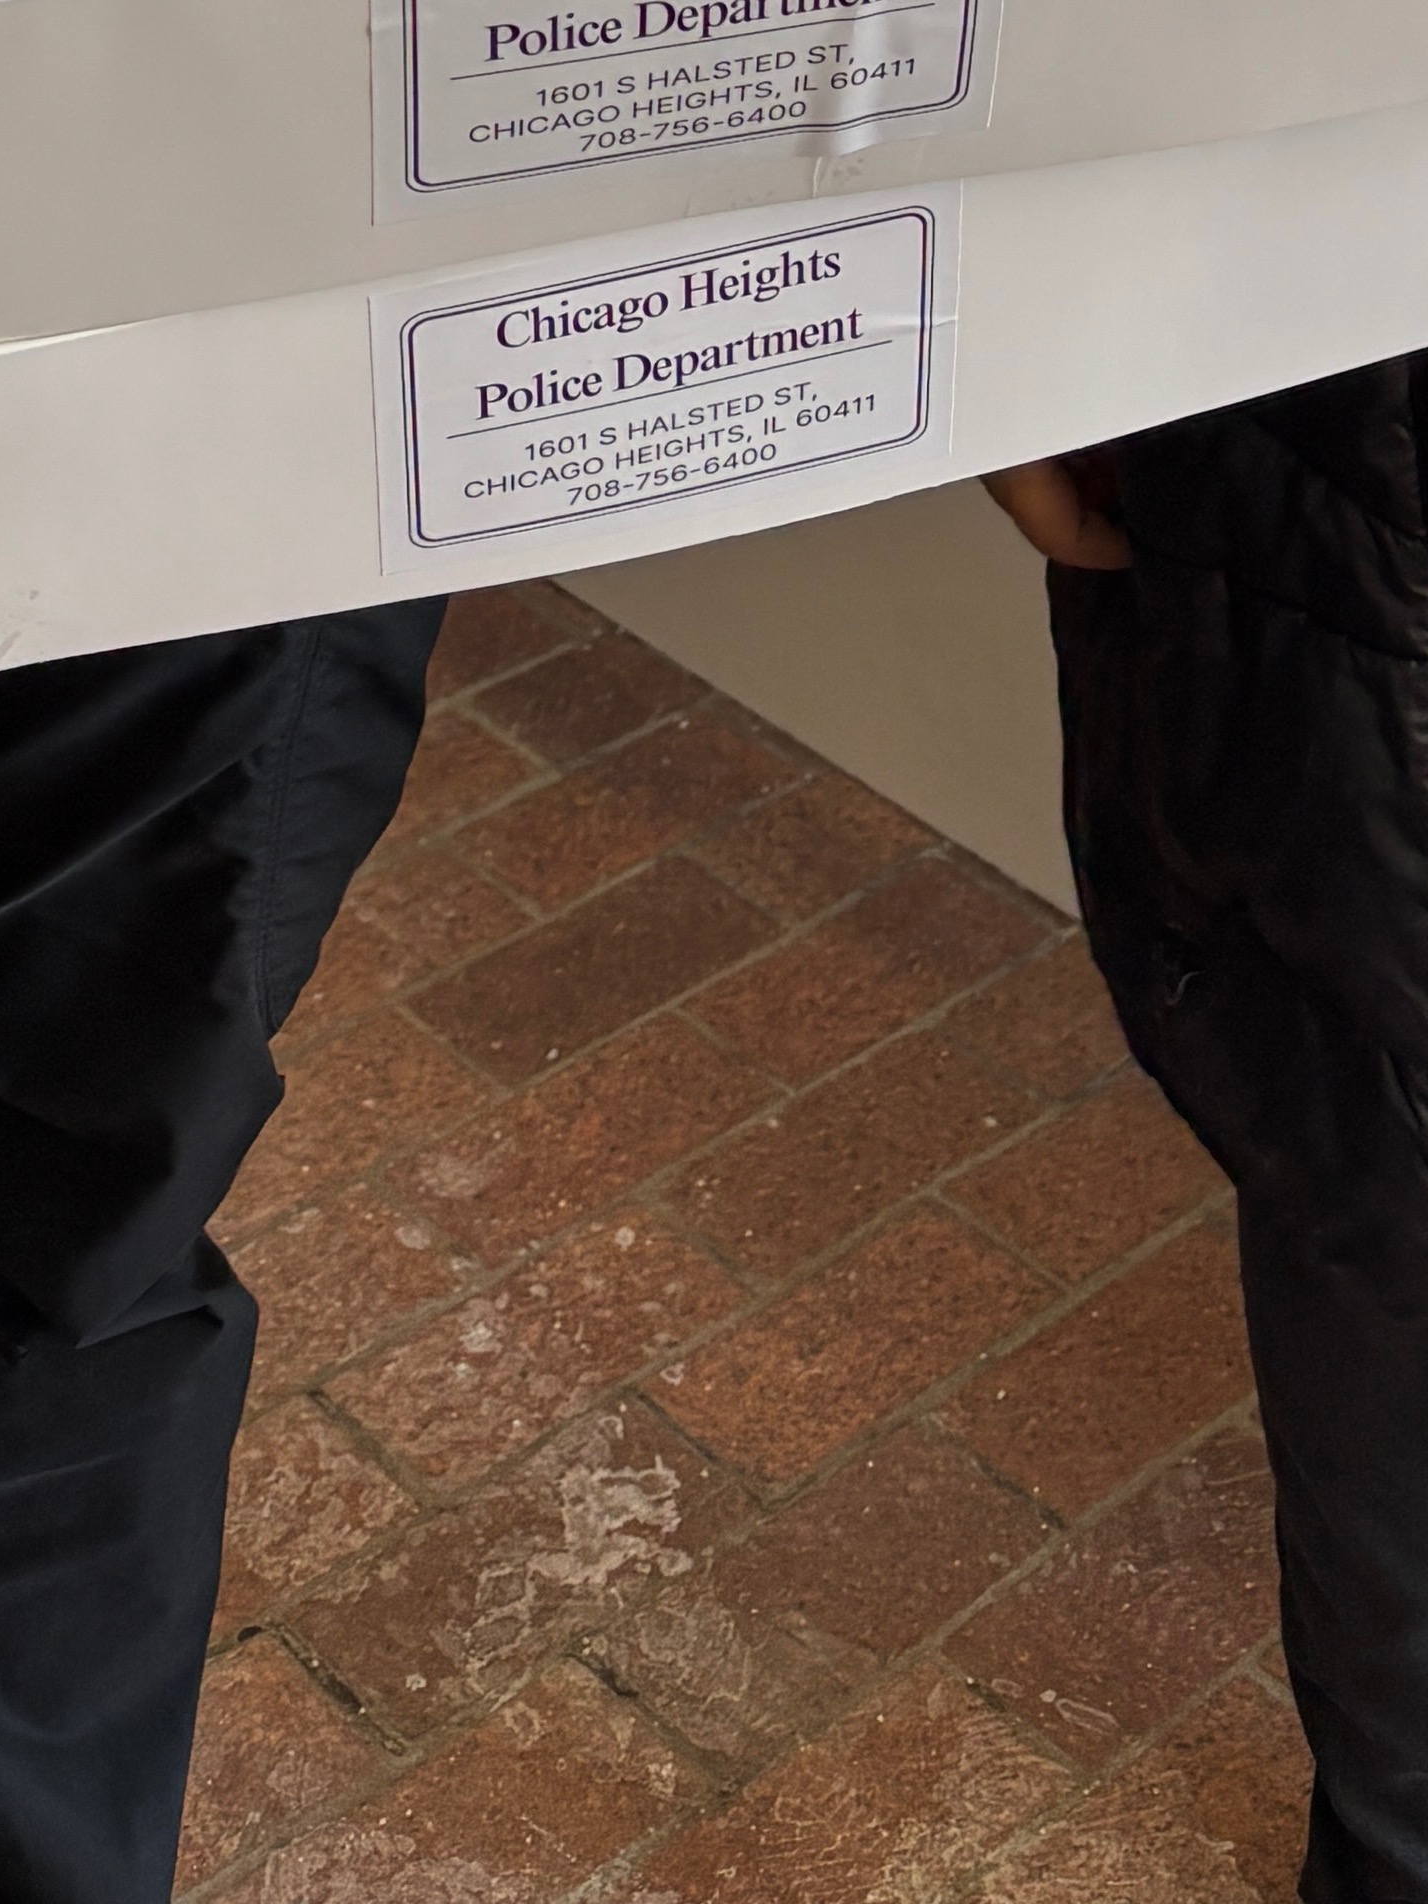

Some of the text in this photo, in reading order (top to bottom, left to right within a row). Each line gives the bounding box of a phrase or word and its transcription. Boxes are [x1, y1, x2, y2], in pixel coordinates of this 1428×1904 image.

[485, 12, 623, 65] Police
[536, 42, 856, 107] 1601 S HALSTED ST,
[467, 57, 918, 144] CHICAGO HEIGHTS, IL 60411
[579, 100, 808, 153] 708-756-6400
[495, 247, 843, 350] Chicago Heights
[475, 307, 864, 422] Police Department
[463, 393, 878, 500] CHICAGO HEIGHTS, IL 60411
[523, 381, 819, 461] 1601 S HALSTED ST,
[567, 442, 778, 507] 708-756-6400
